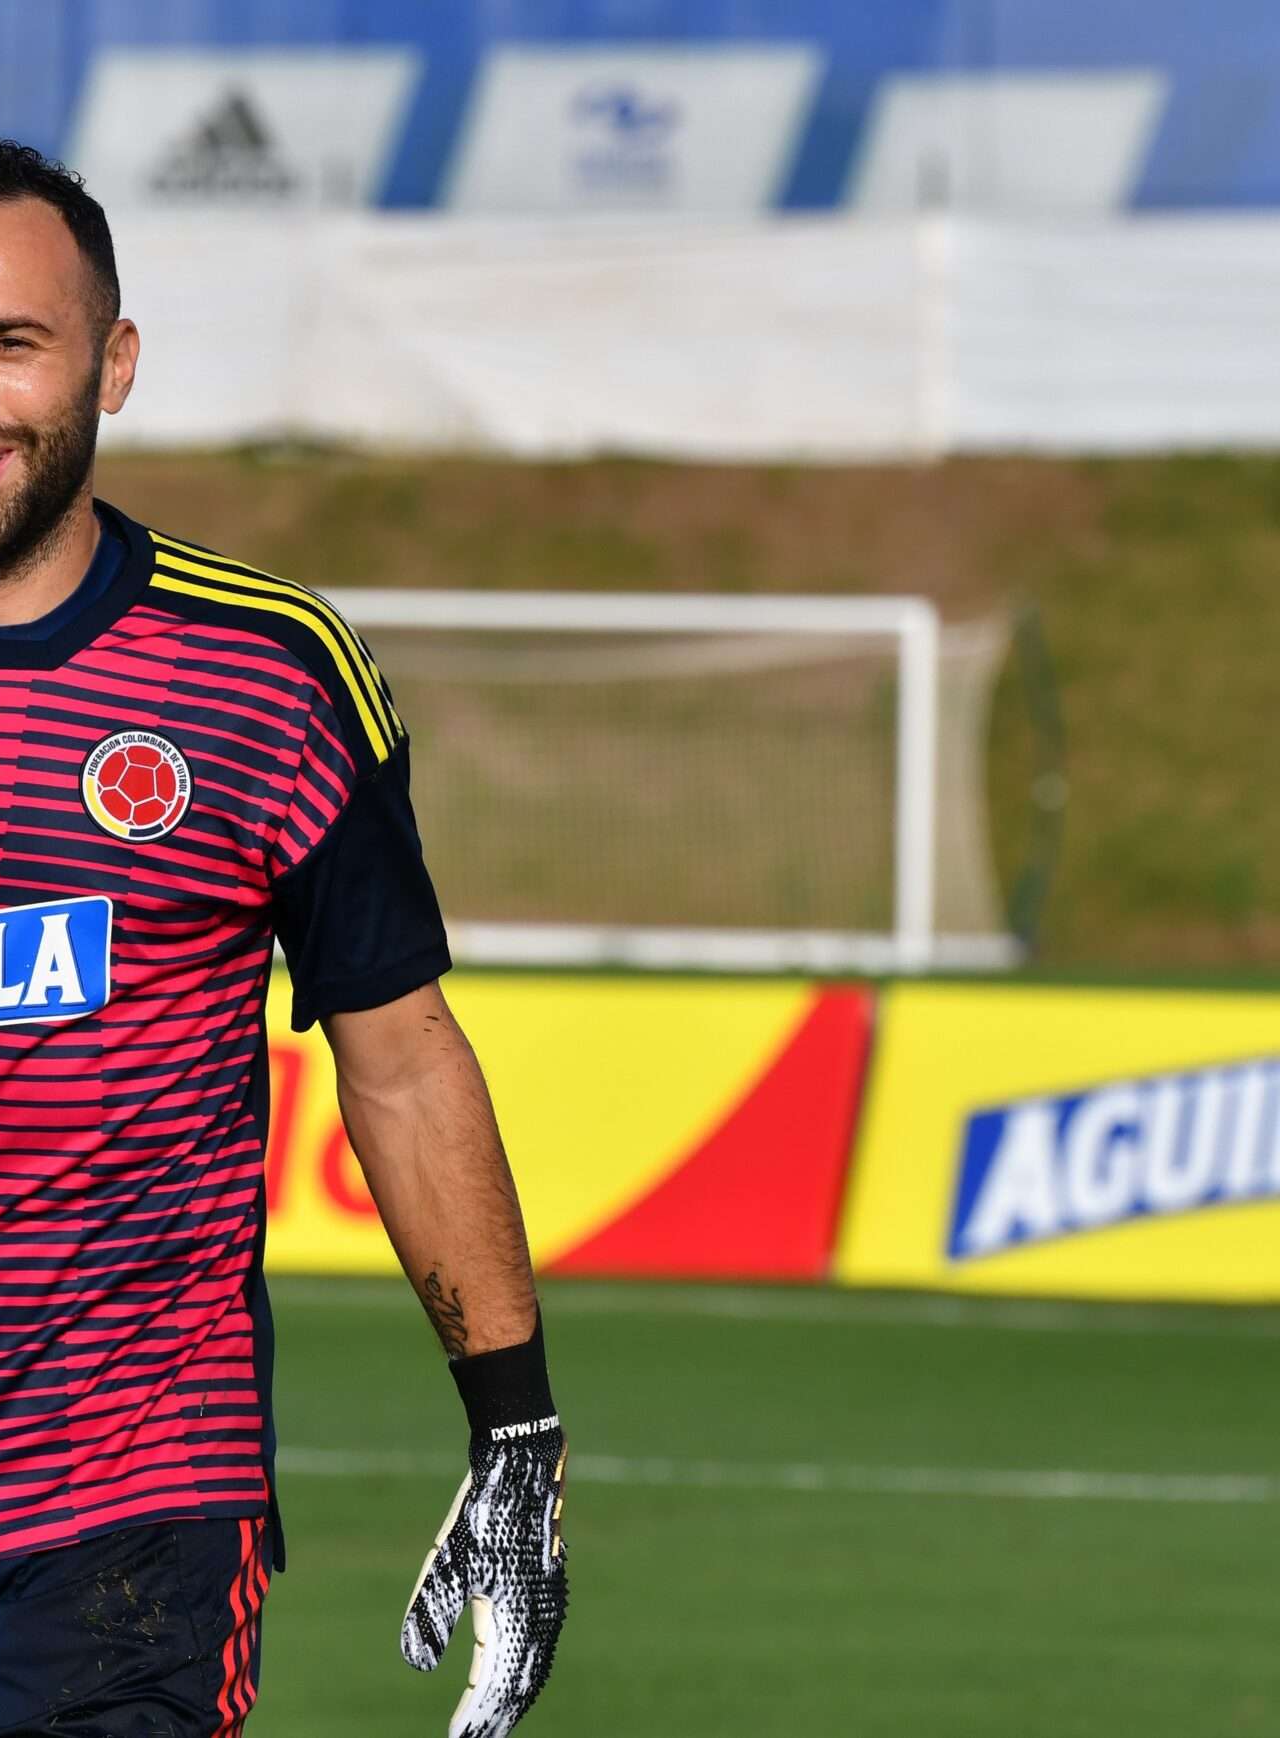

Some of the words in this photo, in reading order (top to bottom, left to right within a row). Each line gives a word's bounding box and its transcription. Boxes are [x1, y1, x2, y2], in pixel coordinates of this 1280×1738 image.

[87, 738, 121, 777] FEDERACION
[122, 734, 172, 754] COLOMBIANA
[170, 753, 180, 763] DE
[175, 763, 187, 793] FUTBOL
[965, 1068, 1280, 1250] AGUI
[491, 1422, 532, 1442] MAXI
